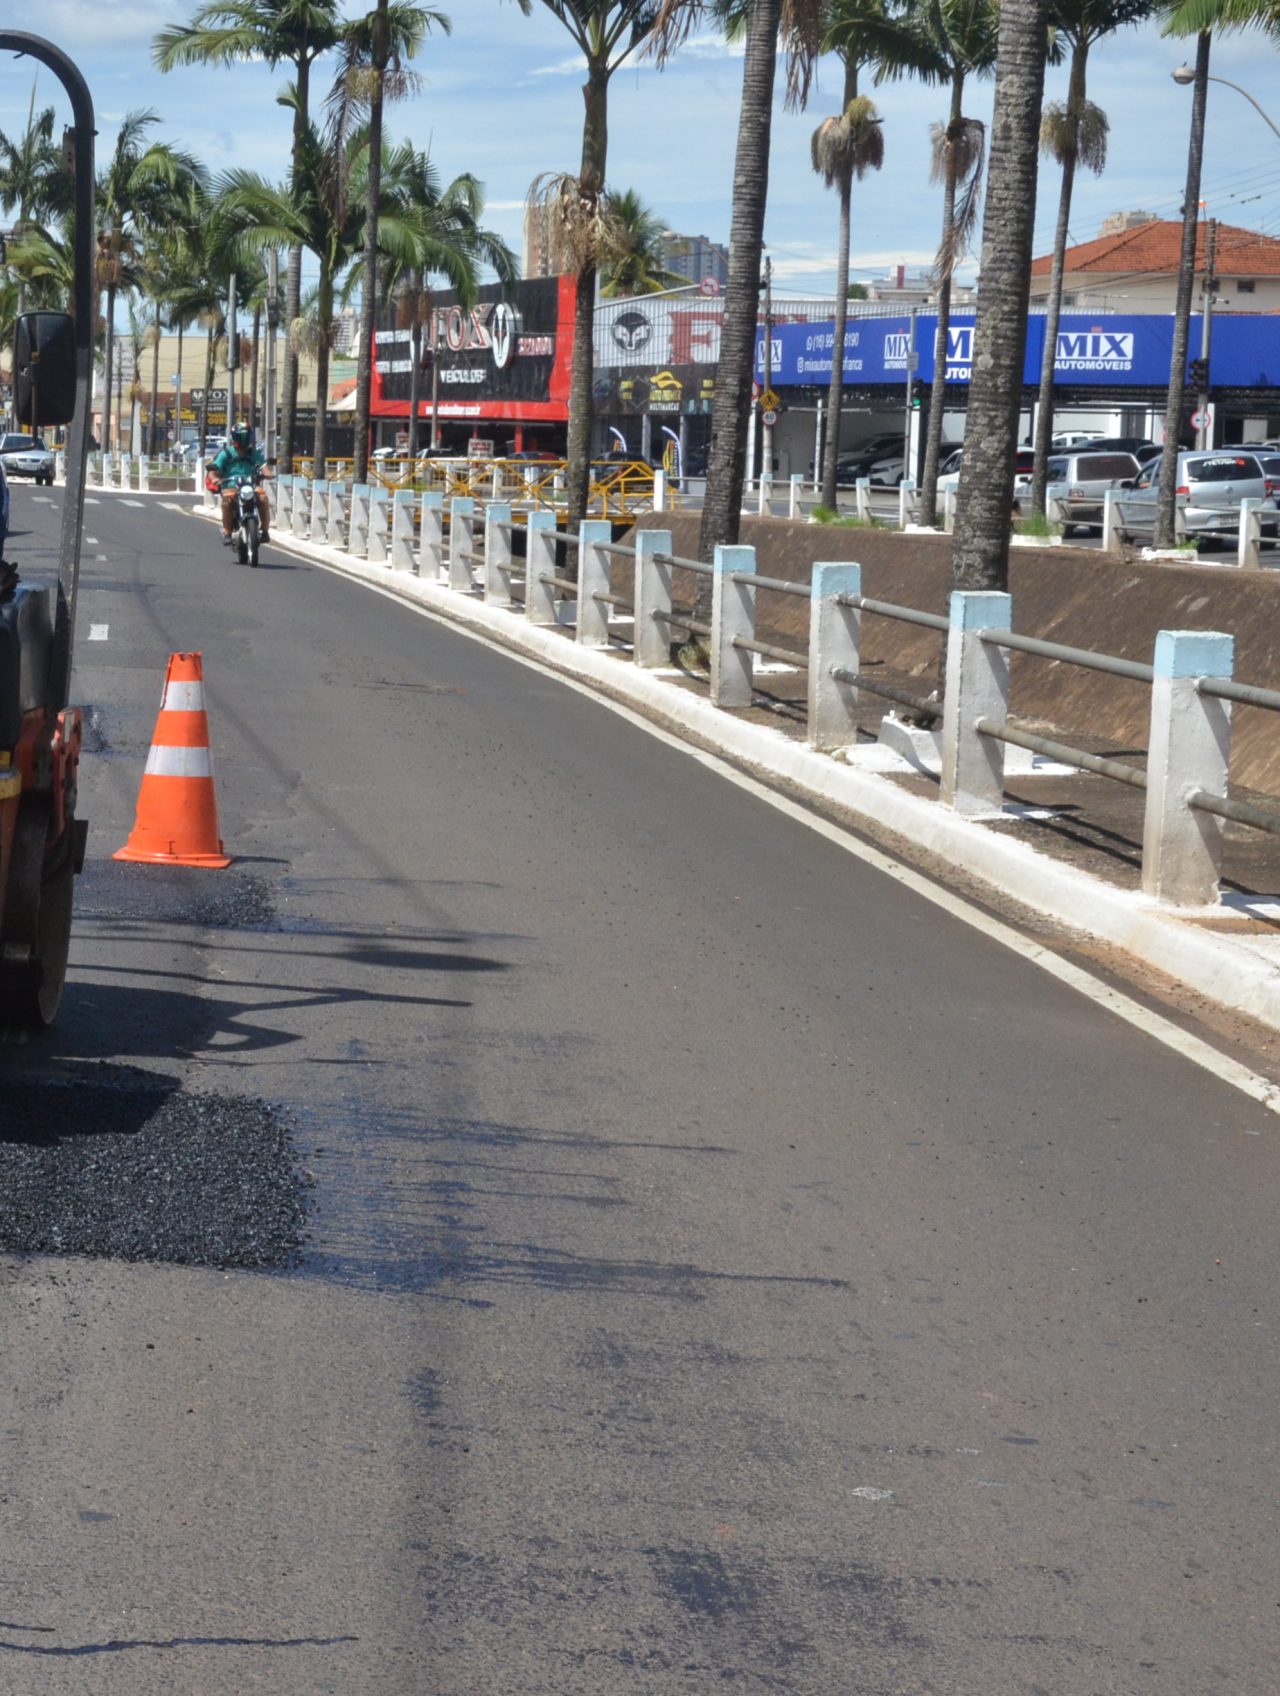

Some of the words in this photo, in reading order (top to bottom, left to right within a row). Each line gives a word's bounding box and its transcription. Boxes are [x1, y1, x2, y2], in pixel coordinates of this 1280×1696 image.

[1058, 327, 1129, 358] MIX
[1054, 359, 1132, 371] AUTOMÓVEIS
[649, 402, 680, 411] MULTIMARCAS
